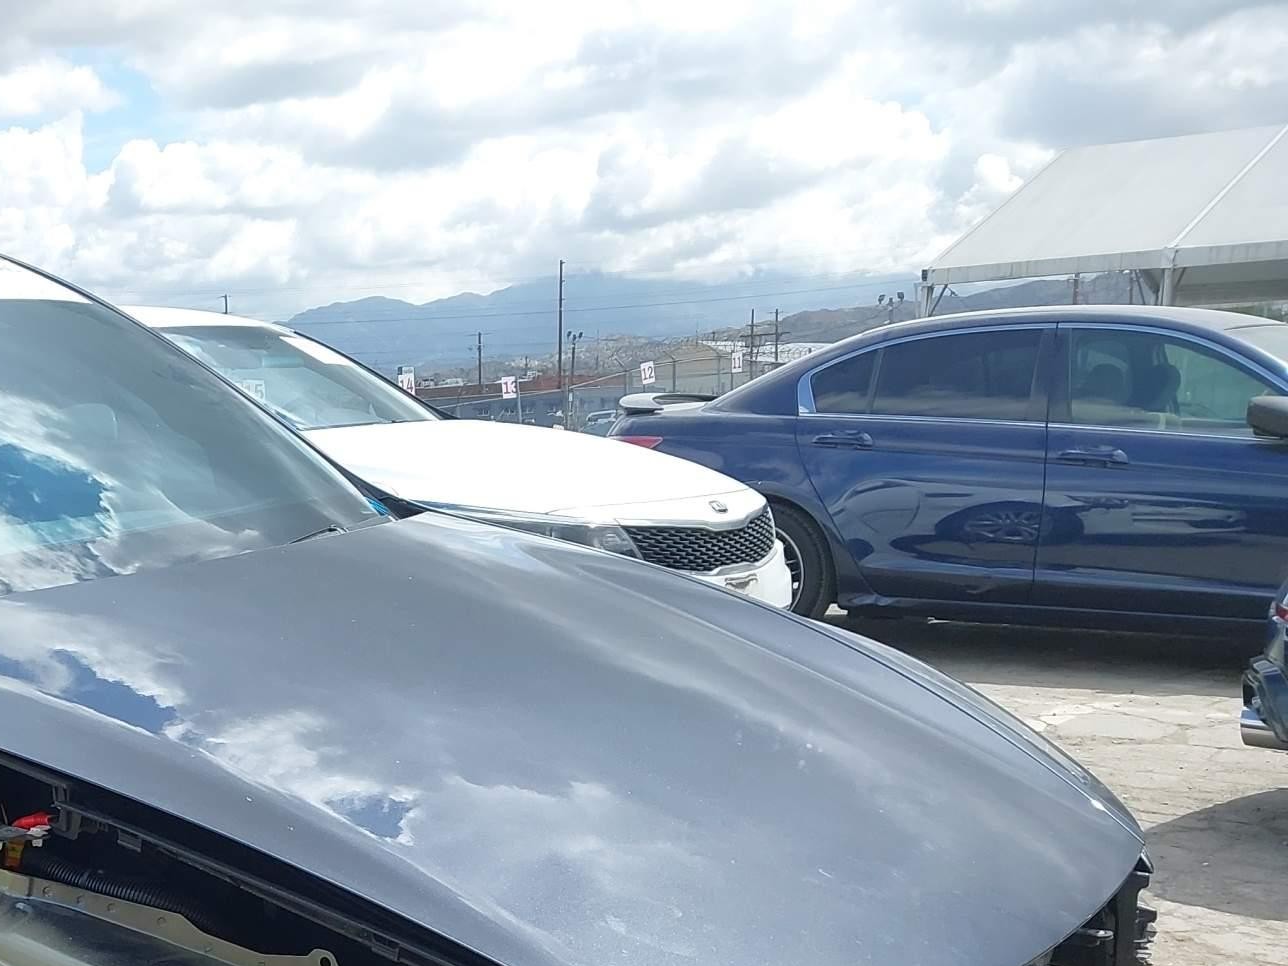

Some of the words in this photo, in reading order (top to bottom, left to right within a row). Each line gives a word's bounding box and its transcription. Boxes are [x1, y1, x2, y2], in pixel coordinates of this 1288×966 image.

[732, 356, 742, 369] 11
[642, 366, 654, 381] 12
[503, 380, 517, 395] 13
